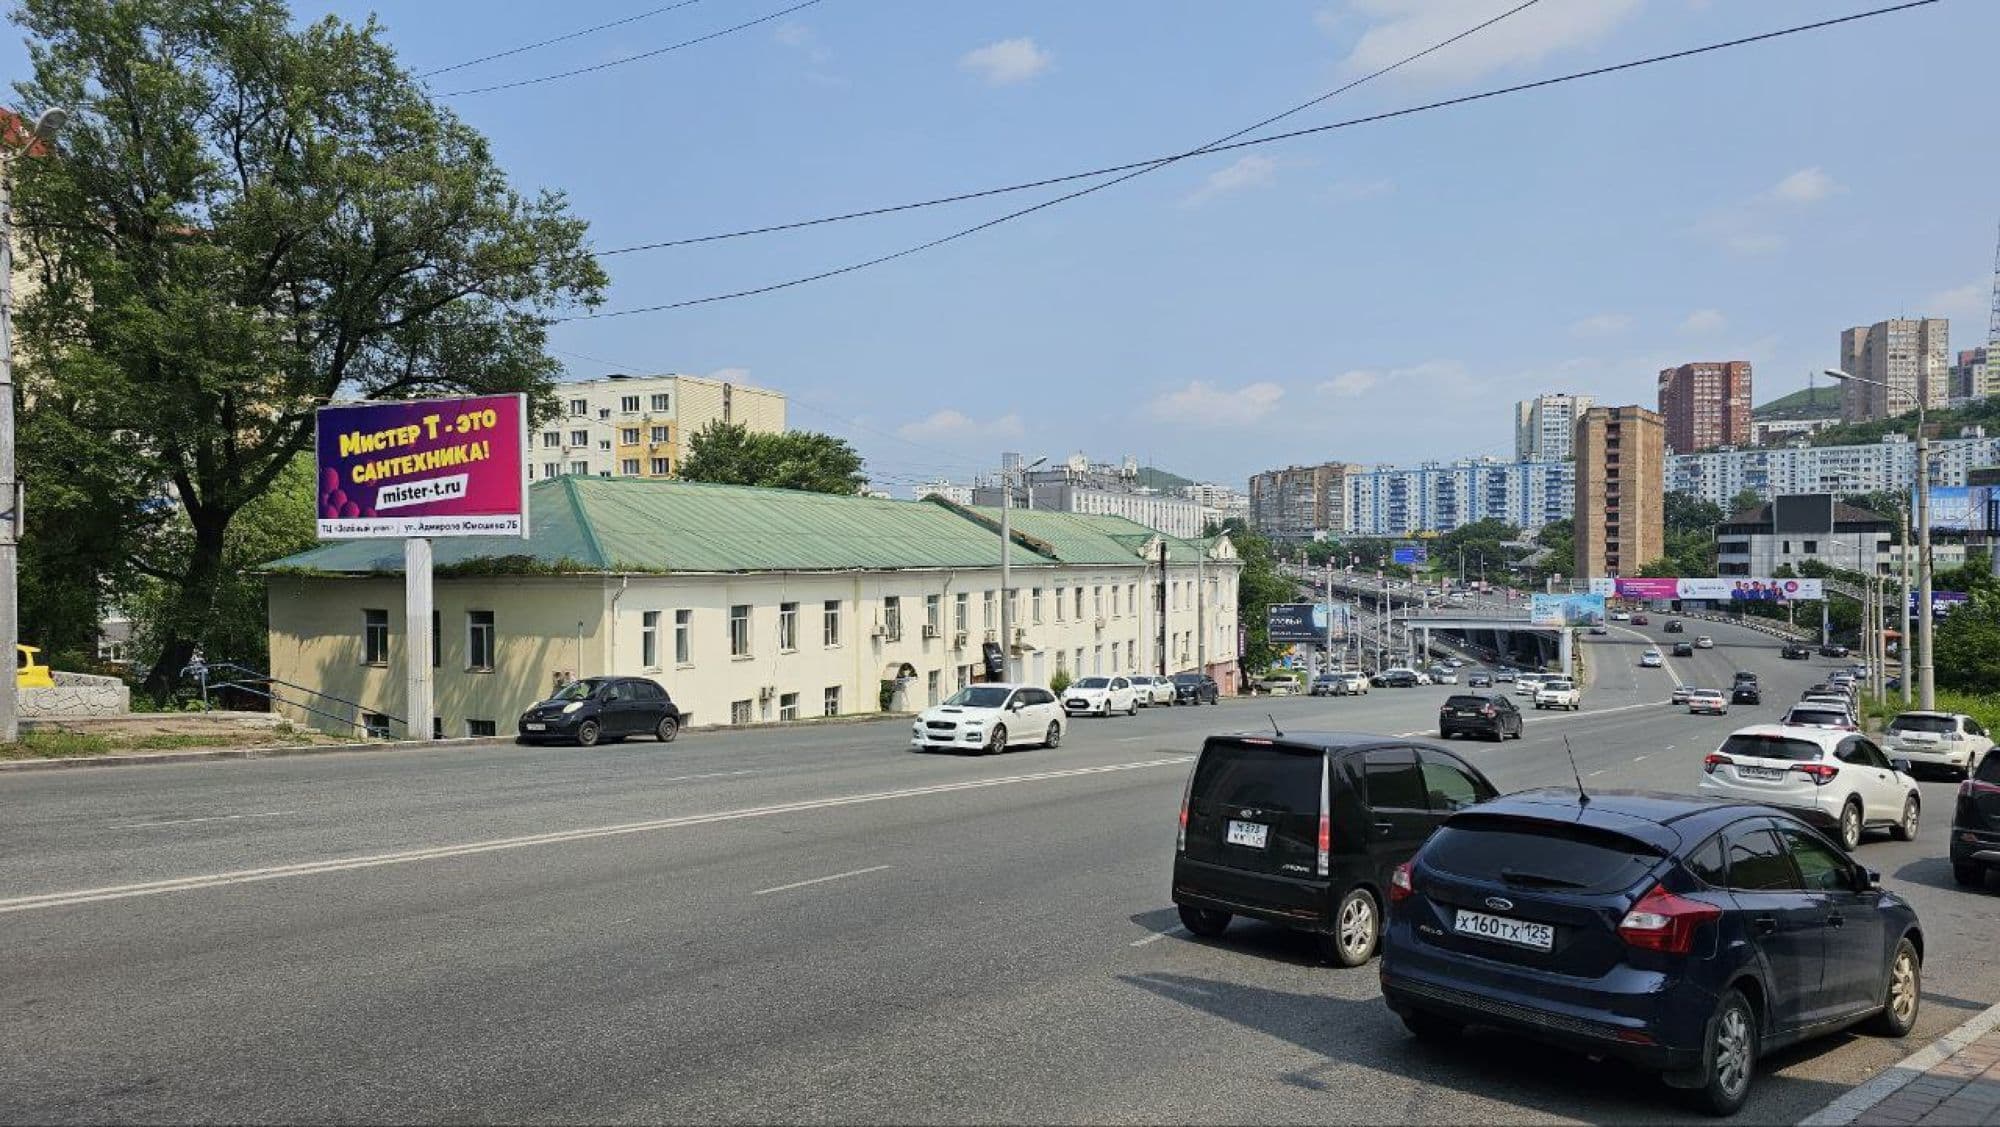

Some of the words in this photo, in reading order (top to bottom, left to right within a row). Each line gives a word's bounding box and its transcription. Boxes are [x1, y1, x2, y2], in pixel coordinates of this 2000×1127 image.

[352, 440, 490, 484] САНТЕХНИКА!
[383, 480, 461, 504] mister-t.ru
[1460, 914, 1520, 939] Х160ТХ
[1524, 923, 1550, 940] 125
